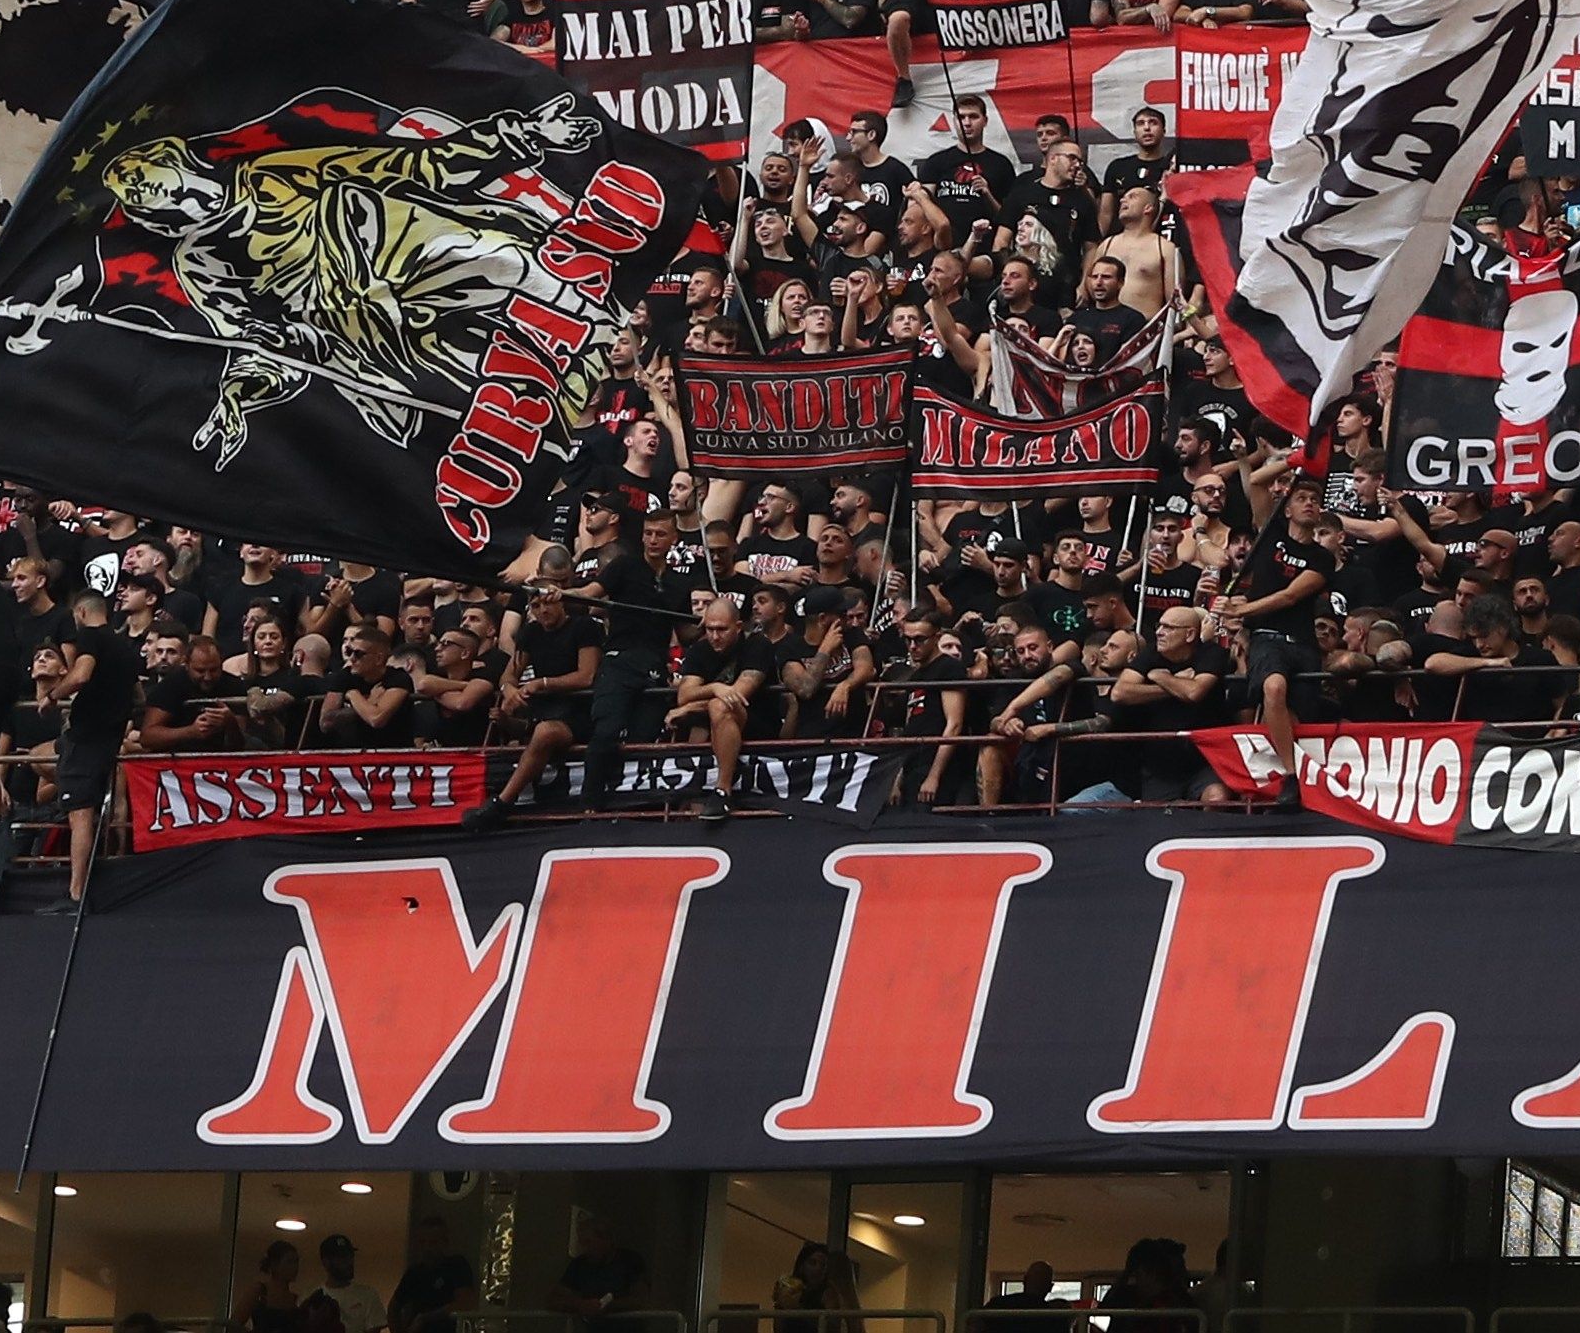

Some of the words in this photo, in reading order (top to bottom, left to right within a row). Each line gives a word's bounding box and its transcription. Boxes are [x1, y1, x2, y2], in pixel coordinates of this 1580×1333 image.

[561, 6, 649, 62] MAI
[591, 76, 743, 133] MODA
[1180, 45, 1269, 112] FINCHÈ
[435, 288, 591, 554] CURVA
[533, 158, 668, 304] SUD
[684, 371, 906, 432] BANDITI
[695, 431, 760, 452] CURVA
[766, 432, 812, 450] SUD
[818, 427, 906, 449] MILANO
[921, 403, 1151, 467] MILANO
[1133, 583, 1168, 598] CRVA
[1168, 586, 1191, 599] SUD
[149, 765, 456, 832] ASSENTI
[515, 749, 882, 814] PESENTI
[1231, 732, 1462, 827] ATONIO
